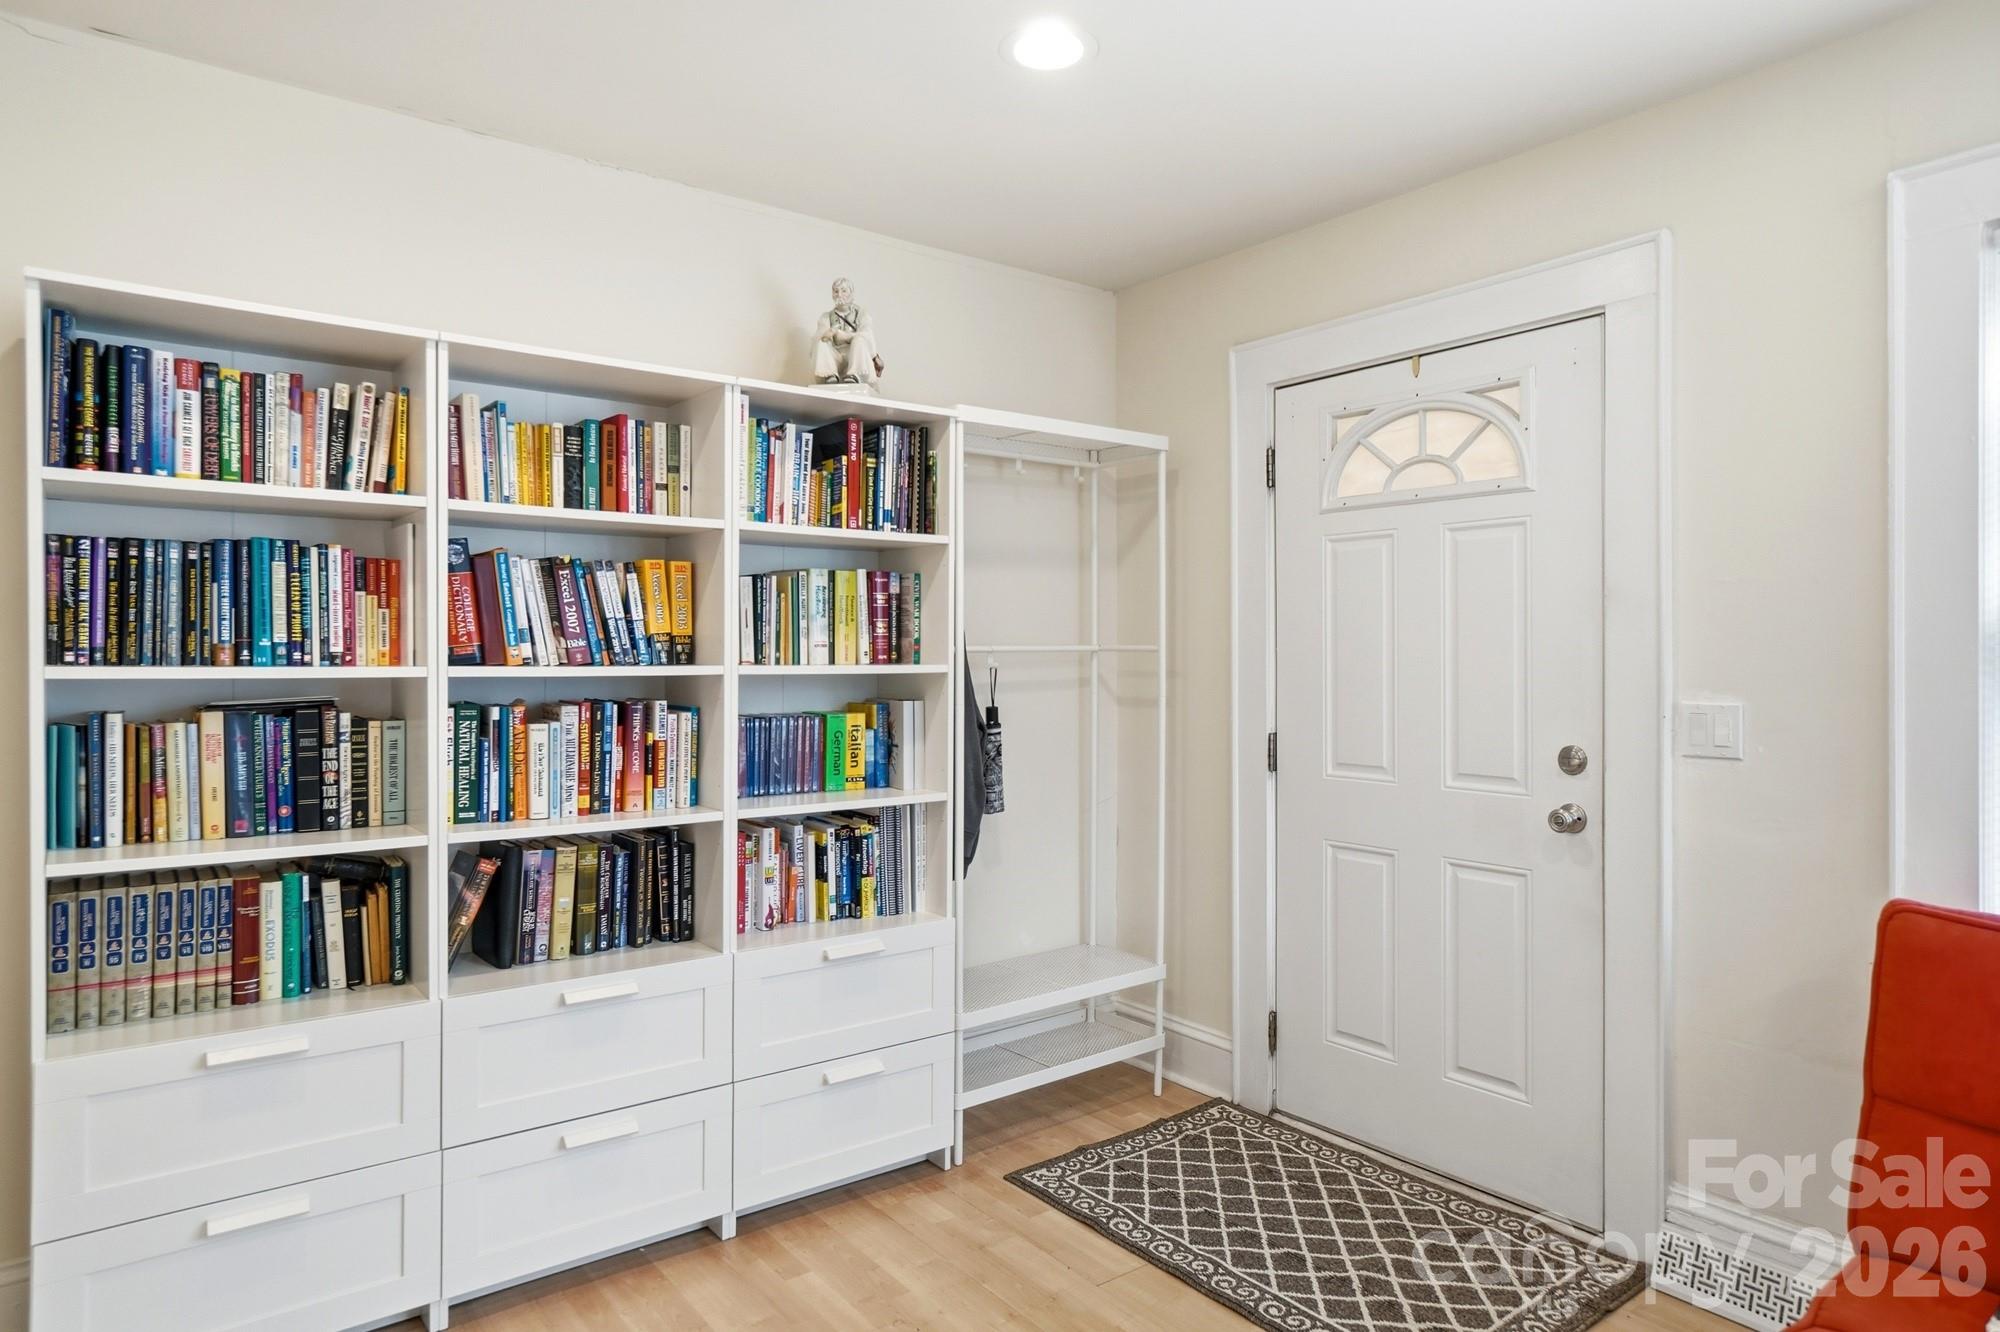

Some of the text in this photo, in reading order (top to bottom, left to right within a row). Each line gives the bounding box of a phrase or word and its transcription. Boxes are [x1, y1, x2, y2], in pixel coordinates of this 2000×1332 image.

[204, 392, 219, 479] TOWERS OF DEBT
[793, 452, 801, 479] BRAIN
[753, 474, 762, 514] COOKBOOK
[78, 557, 91, 590] MILLION
[913, 580, 921, 600] CIVIL
[451, 576, 469, 644] DICTIONARY
[461, 586, 476, 633] COLLEGE
[558, 569, 582, 634] Excel 2007
[675, 574, 689, 630] Excel 2003
[78, 622, 91, 649] ESTATE
[566, 639, 588, 649] Bible
[658, 702, 667, 713] JIM
[594, 730, 603, 761] TRADING
[631, 712, 641, 742] THINGS
[848, 724, 862, 768] Italian
[458, 720, 472, 808] NATURAL HEALING
[565, 737, 577, 784] MILLIONAIRE
[631, 750, 641, 774] COME
[831, 730, 843, 776] German
[796, 837, 805, 863] LIVER
[861, 838, 869, 875] Networking
[264, 919, 276, 963] EXODUS
